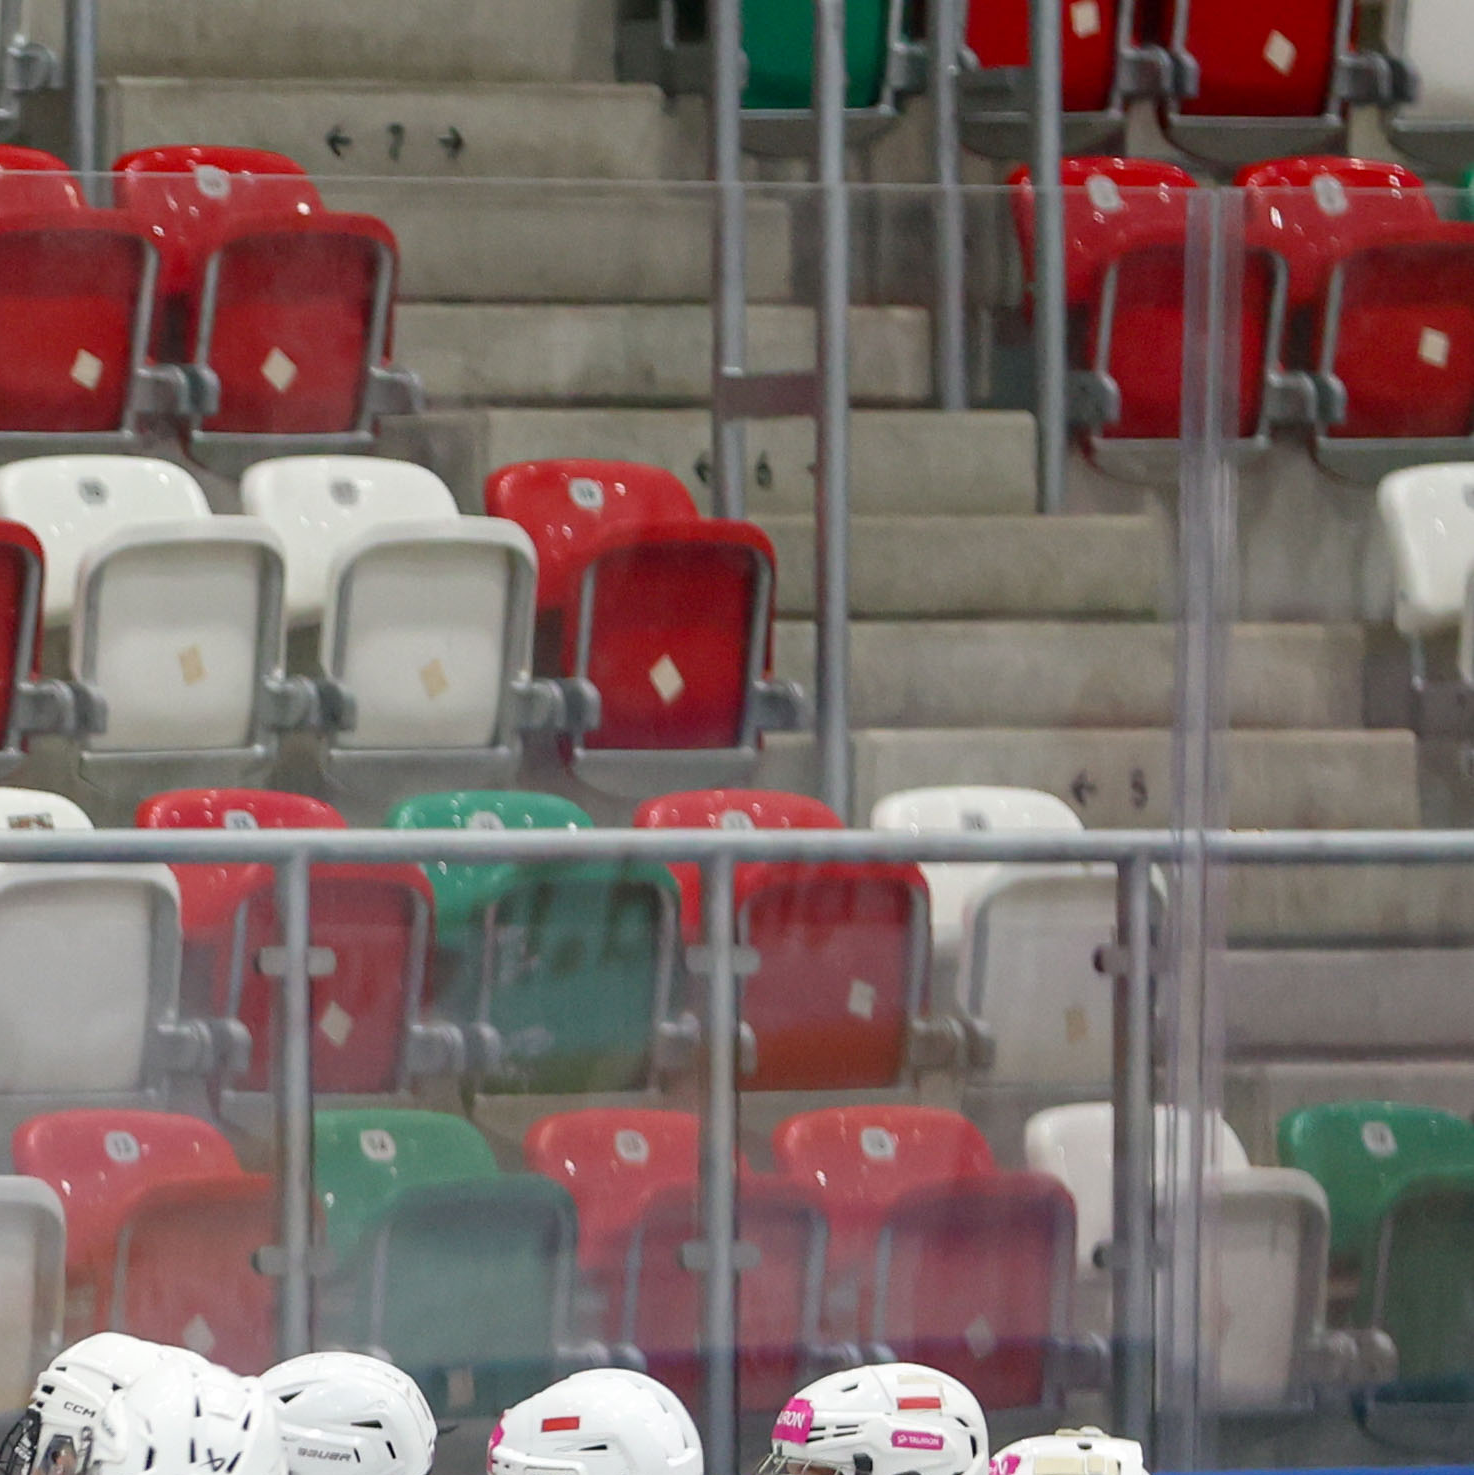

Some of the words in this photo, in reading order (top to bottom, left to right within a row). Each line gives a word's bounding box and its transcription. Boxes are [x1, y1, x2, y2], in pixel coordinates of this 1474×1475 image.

[63, 1401, 97, 1418] CCM
[909, 1435, 940, 1447] TAURON
[298, 1447, 352, 1462] BAUER
